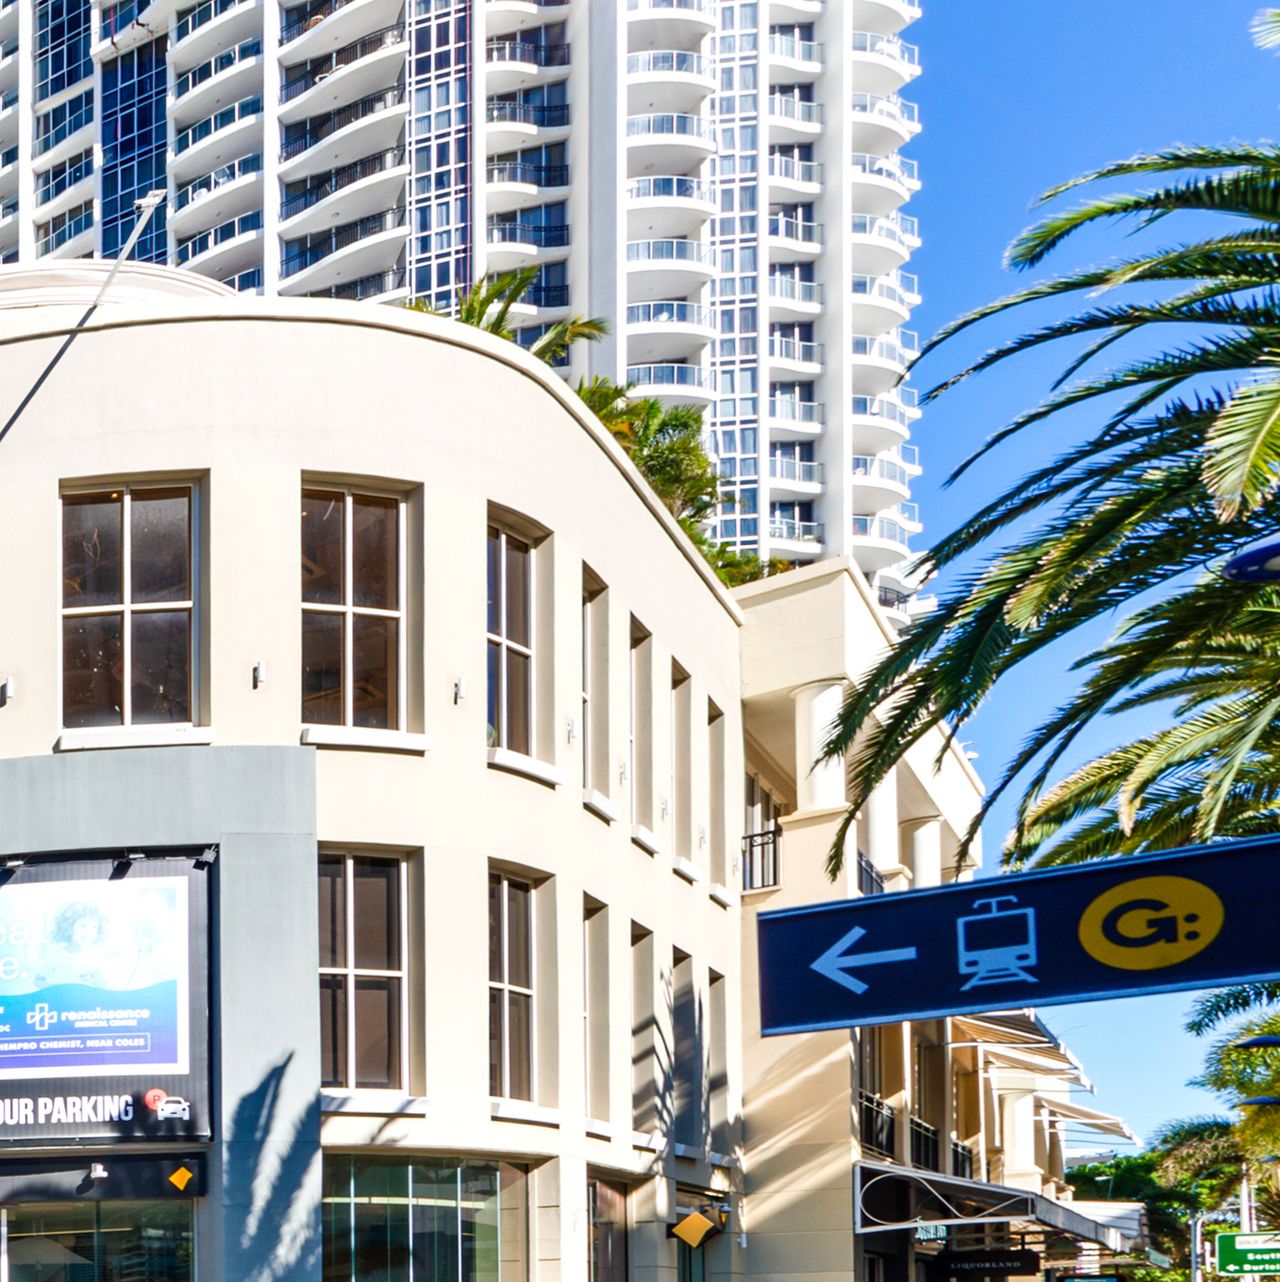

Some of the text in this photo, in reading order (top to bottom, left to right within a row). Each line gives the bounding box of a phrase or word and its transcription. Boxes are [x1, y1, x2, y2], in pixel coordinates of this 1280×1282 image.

[61, 1006, 151, 1021] renaissance
[39, 1039, 84, 1050] CHEMIST,
[86, 1038, 113, 1048] NEAR
[115, 1037, 145, 1047] COLES
[38, 1094, 134, 1124] PARKING
[950, 1261, 1022, 1270] LIQUORLAND
